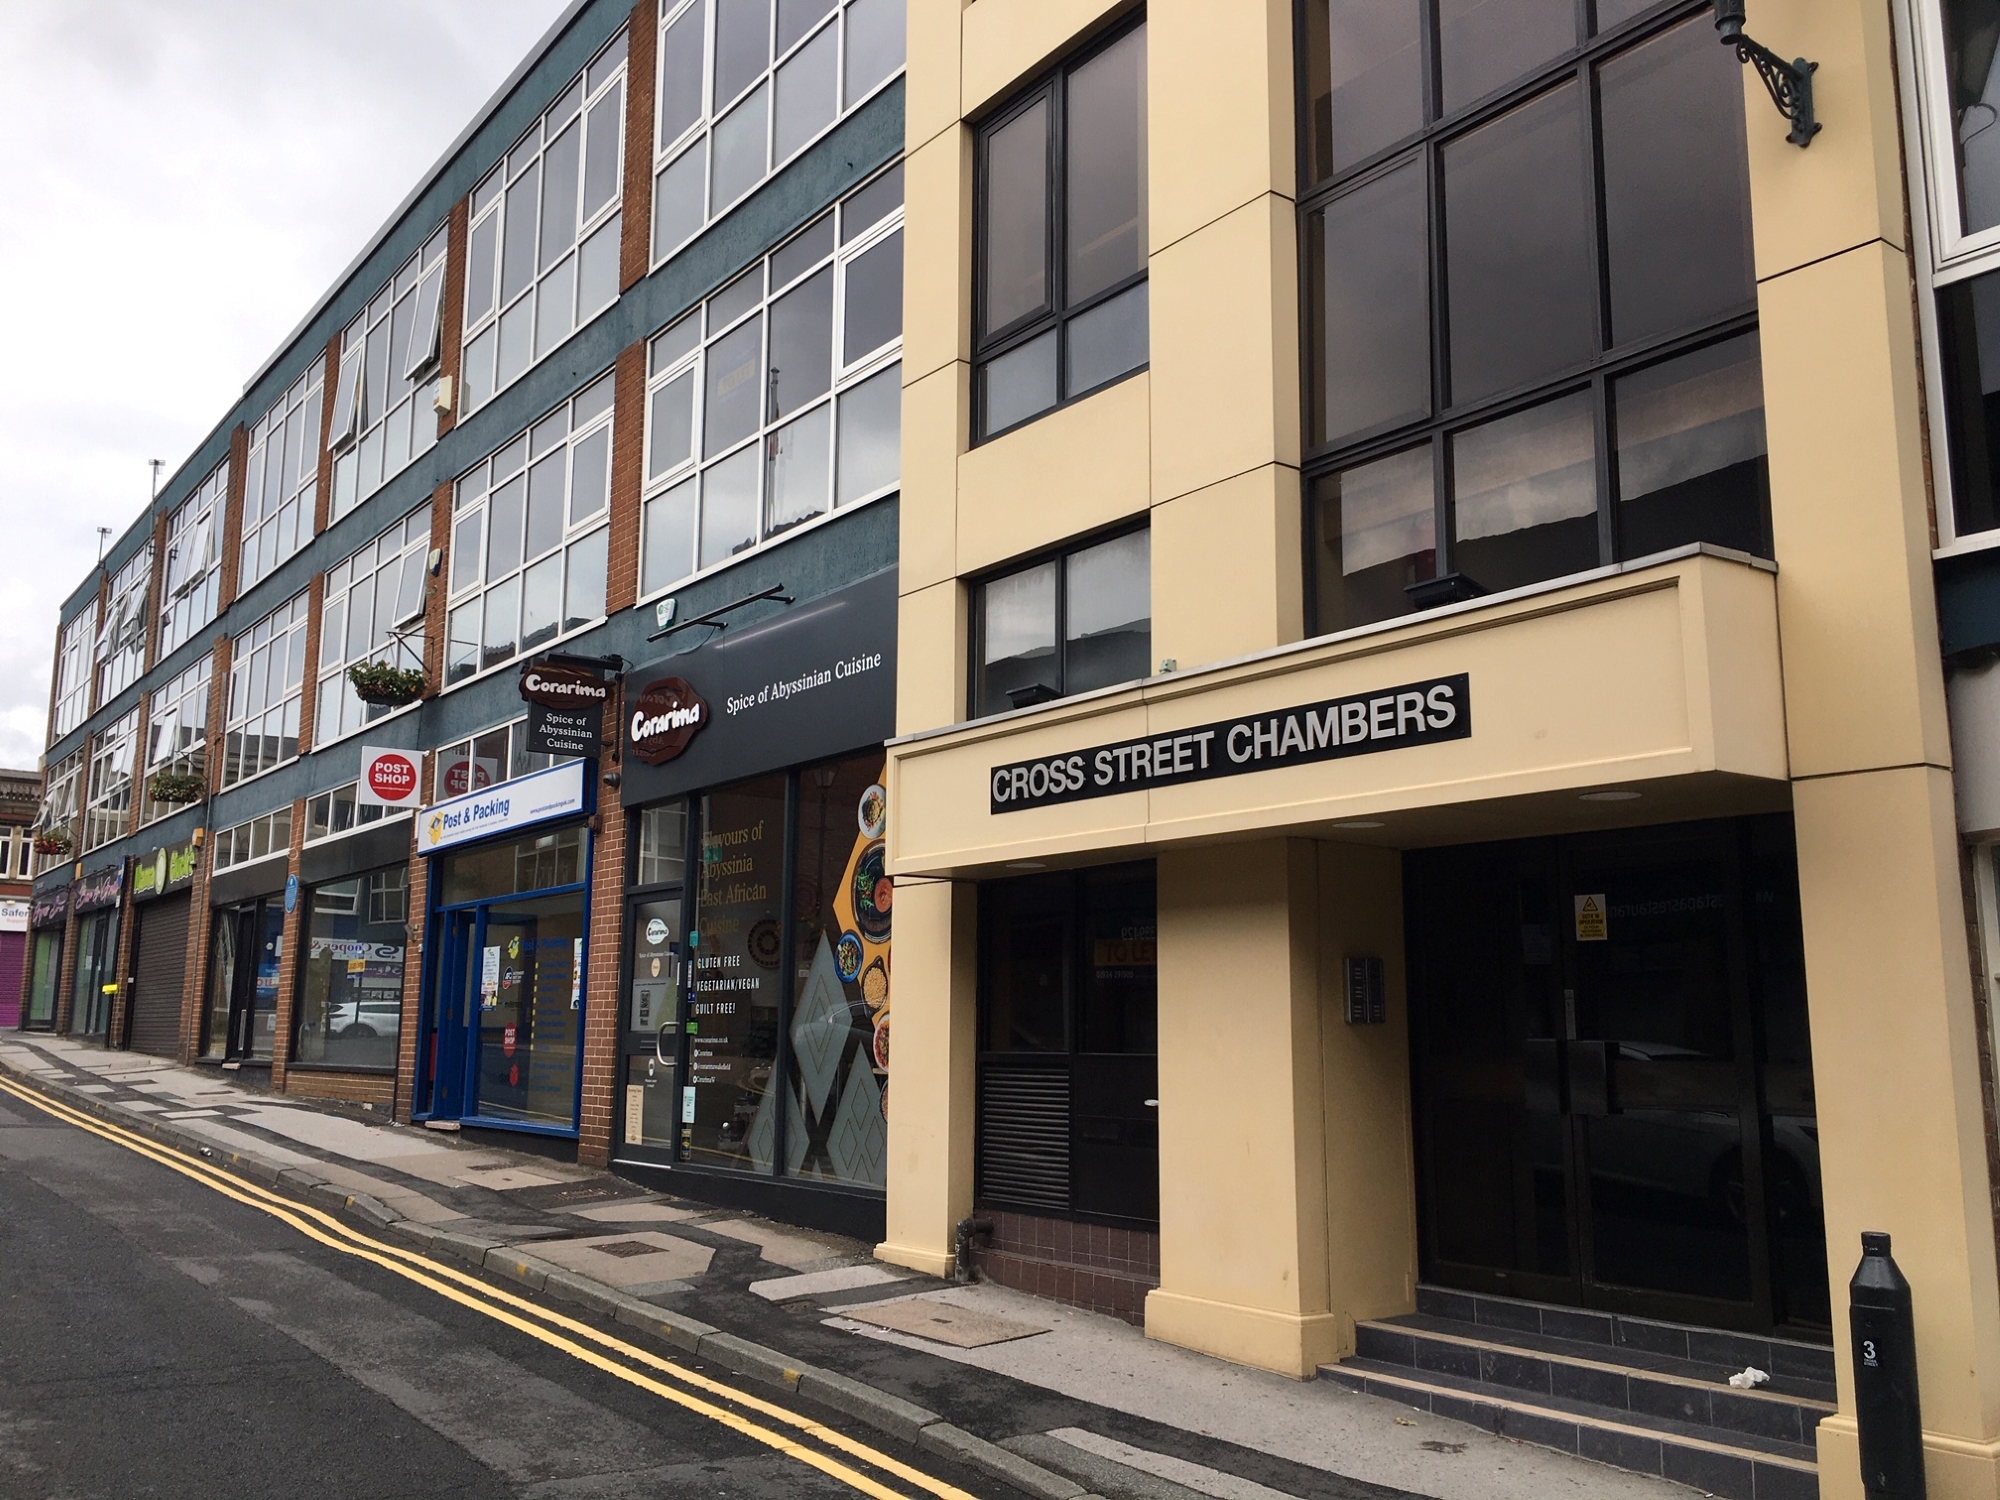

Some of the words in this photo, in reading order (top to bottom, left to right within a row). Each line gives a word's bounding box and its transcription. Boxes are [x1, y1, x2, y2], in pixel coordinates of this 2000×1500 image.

[525, 674, 606, 698] Corarima
[726, 694, 755, 715] Spice
[758, 686, 769, 703] of
[771, 669, 832, 700] Abyssinian
[835, 652, 882, 679] Cuisine
[546, 713, 573, 726] Spice
[576, 717, 587, 726] of
[631, 701, 700, 742] Corarima
[539, 724, 593, 738] Abyssinian
[546, 738, 584, 750] Cuisine
[991, 755, 1085, 803] CROSS
[1093, 730, 1215, 786] STREET
[1226, 684, 1457, 764] CHAMBERS
[375, 763, 410, 773] POST
[374, 773, 410, 784] SHOP
[442, 810, 462, 830] Post
[463, 807, 471, 822] &
[473, 798, 510, 819] Packing
[702, 828, 748, 850] Flavours
[751, 820, 764, 841] of
[701, 853, 753, 881] Abyssinia
[700, 888, 723, 907] East
[725, 883, 767, 904] African
[1132, 941, 1157, 962] LE
[697, 957, 721, 969] GLUTEN
[724, 956, 741, 967] FREE
[696, 978, 760, 991] VEGETARIAN/VEGAN
[695, 1003, 714, 1014] GUILT
[716, 1003, 736, 1014] FREE!
[1863, 1340, 1876, 1359] 3
